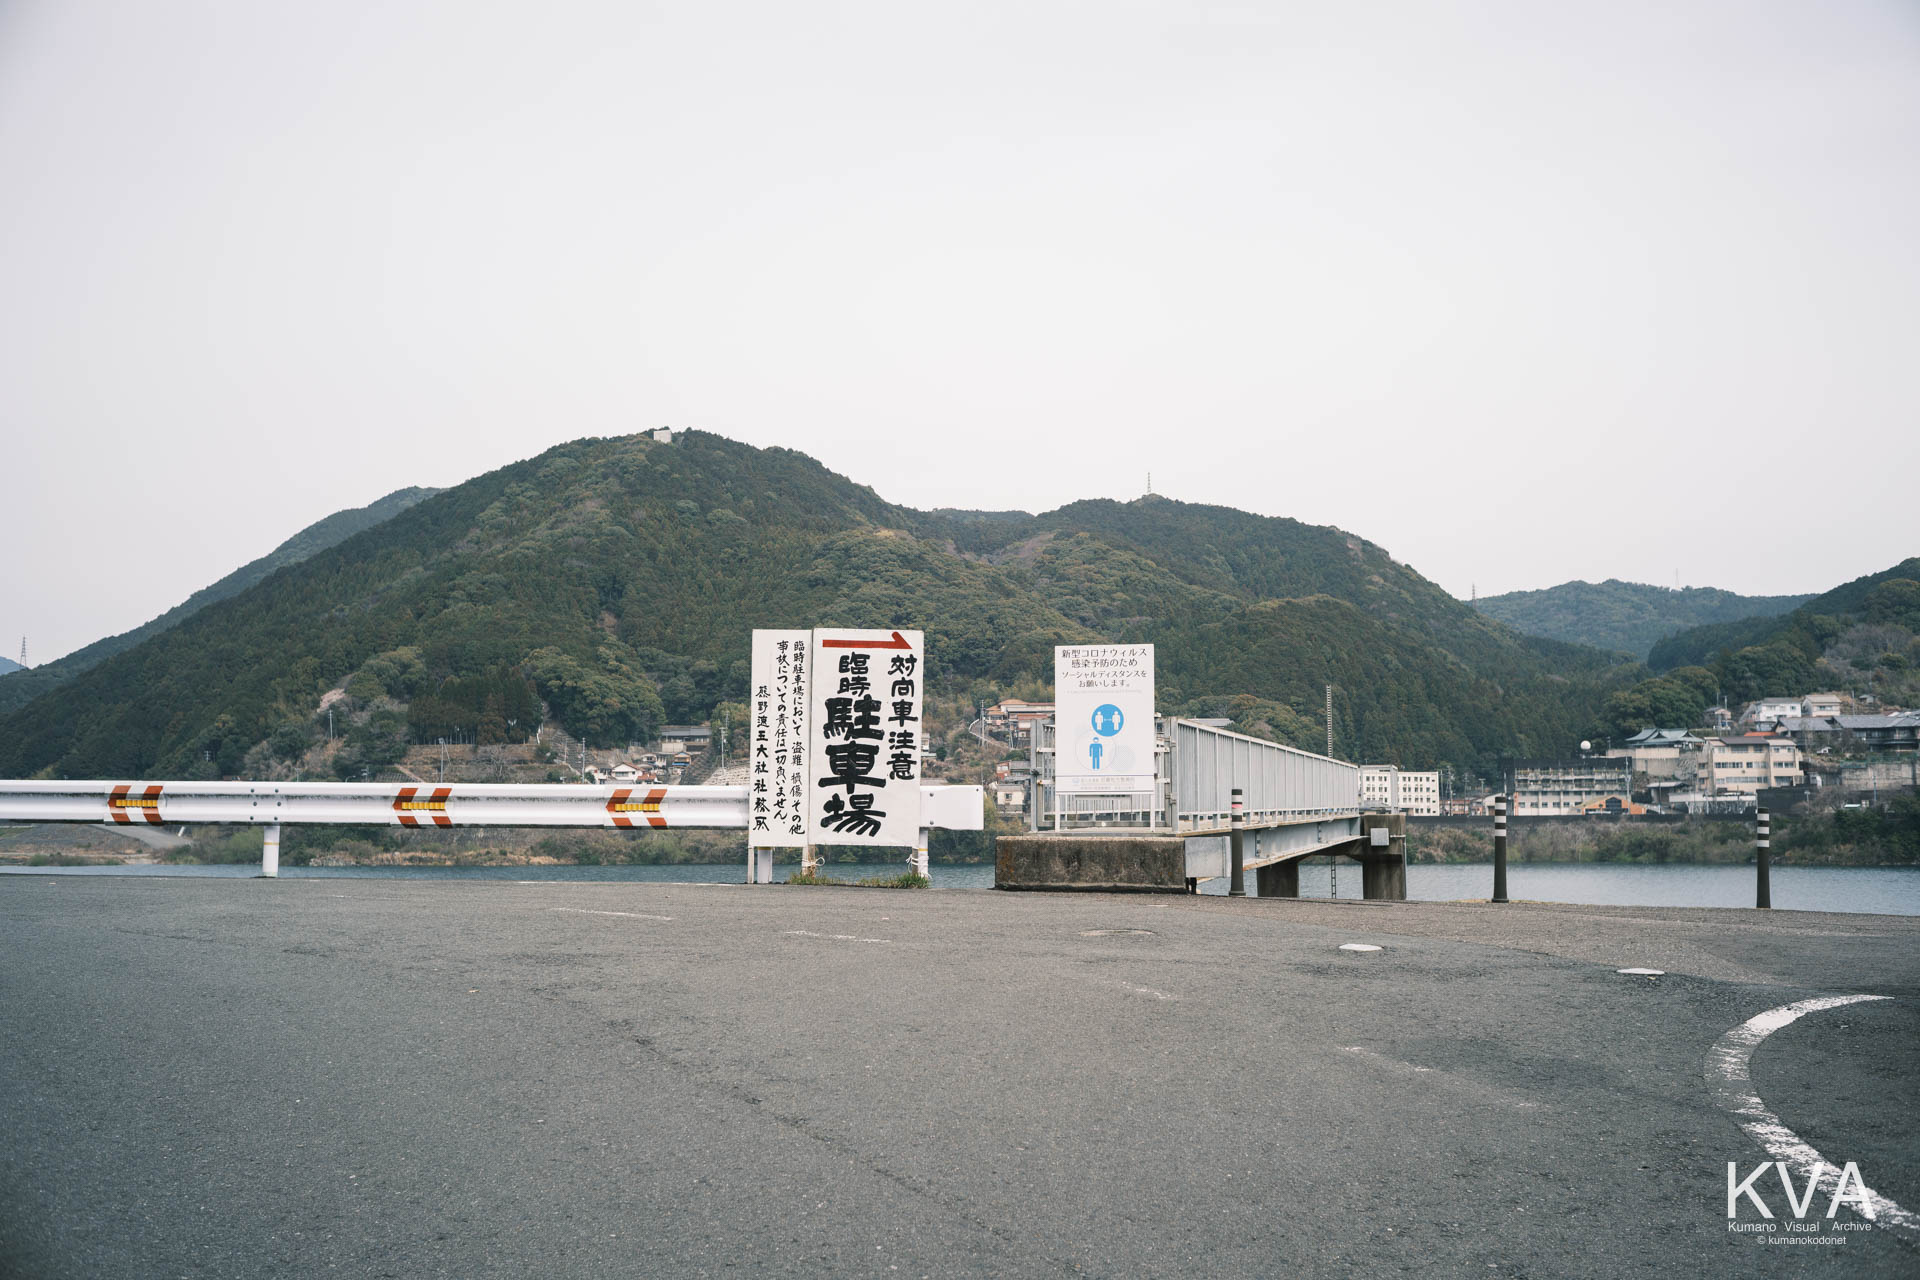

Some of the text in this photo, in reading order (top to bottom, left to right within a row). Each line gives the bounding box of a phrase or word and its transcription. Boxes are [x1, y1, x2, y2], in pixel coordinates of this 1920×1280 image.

[1062, 648, 1147, 658] 新型コロナウィルス
[1072, 658, 1138, 668] 感染予防のため
[1062, 670, 1148, 679] ソーシャルディスタンスを
[1079, 680, 1130, 688] お願いします。
[887, 654, 919, 780] 対向車注意
[818, 652, 886, 837] 臨時駐車場
